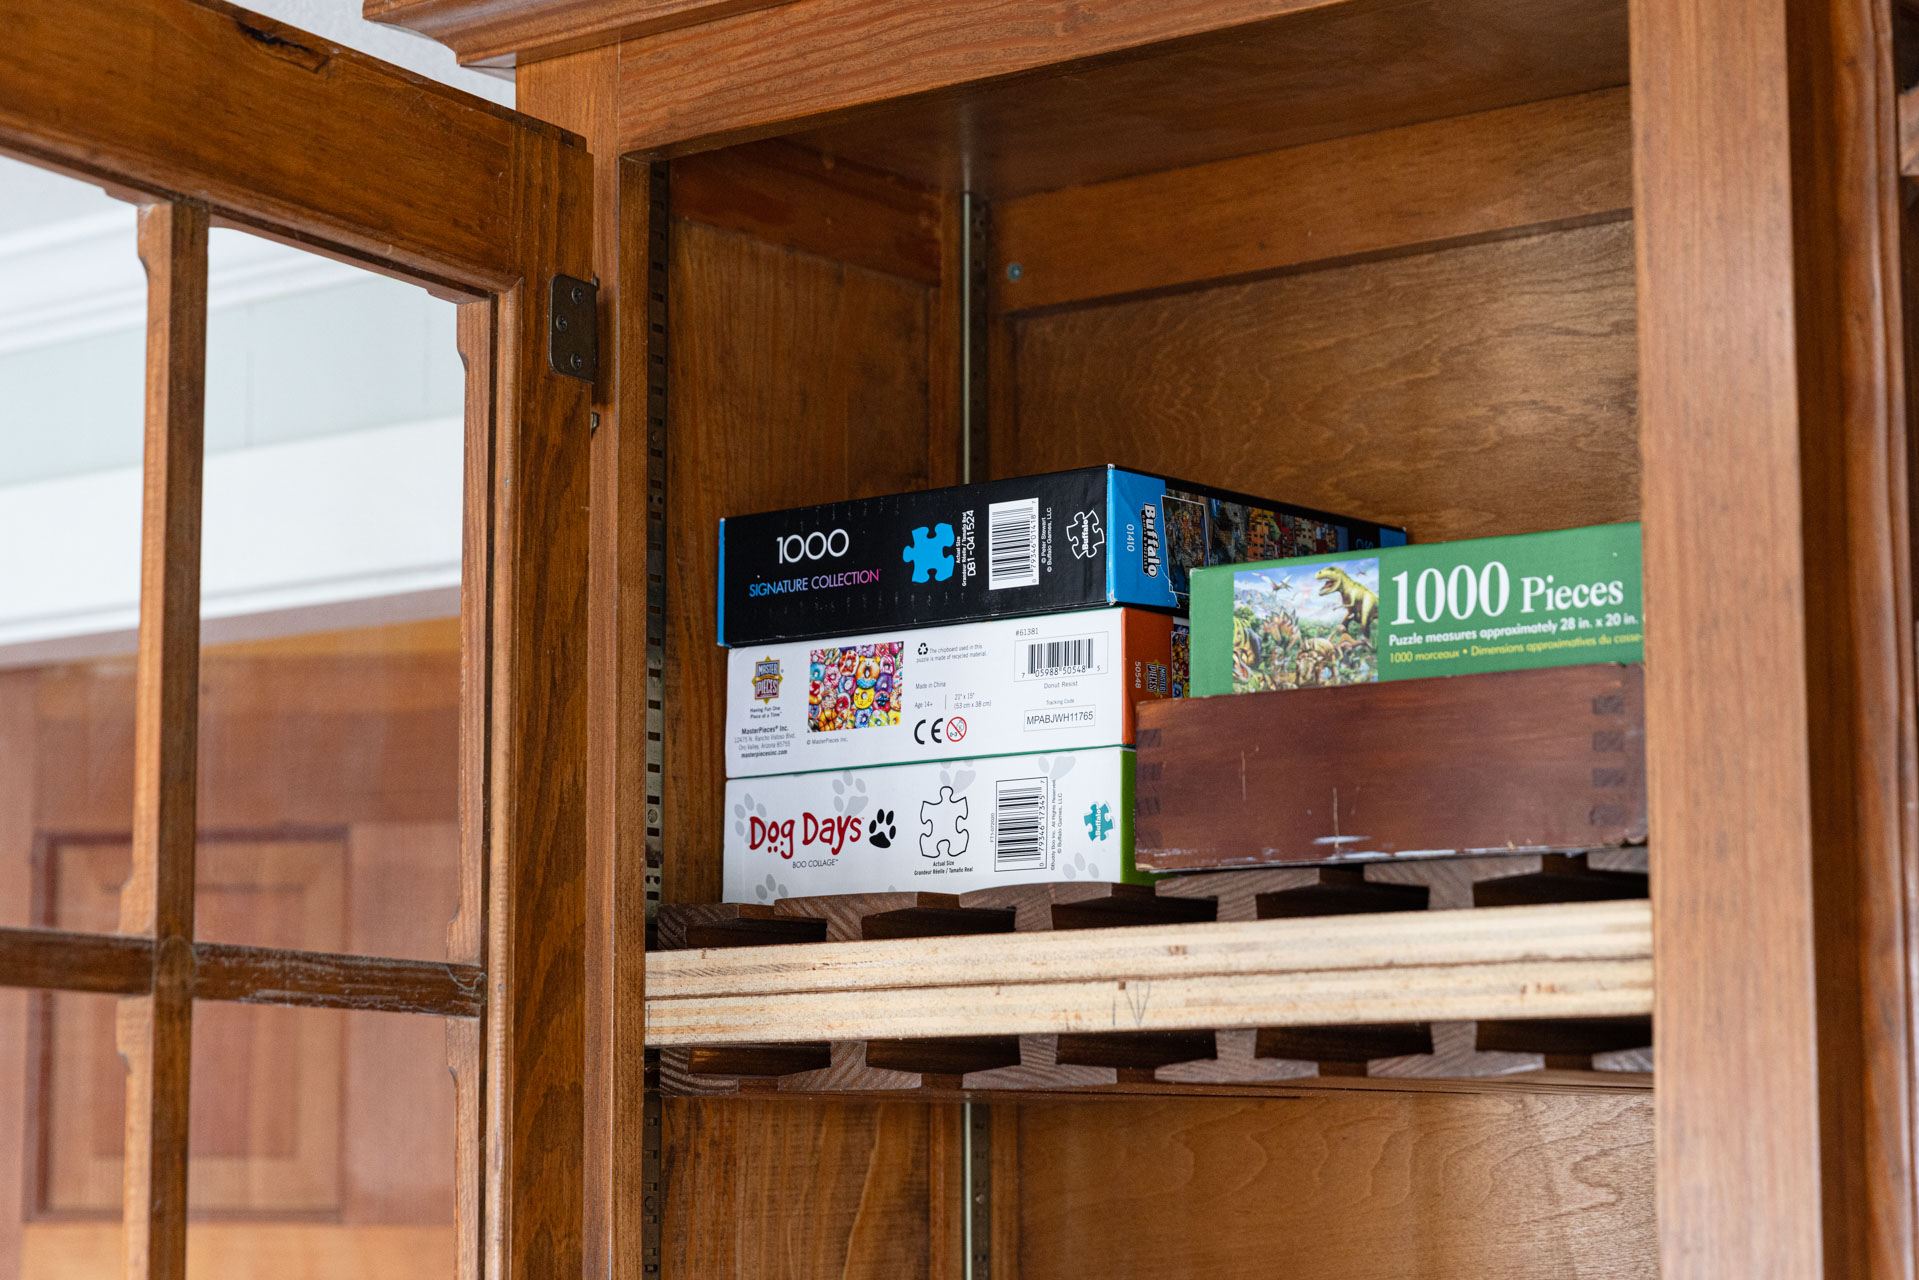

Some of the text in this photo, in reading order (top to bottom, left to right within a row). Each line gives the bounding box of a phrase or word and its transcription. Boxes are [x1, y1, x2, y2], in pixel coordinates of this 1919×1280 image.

[776, 528, 849, 564] 1000
[967, 510, 976, 576] DB1-041524
[1126, 524, 1135, 552] 01410
[1144, 504, 1160, 577] Buffalo
[749, 578, 808, 598] SIGNATURE
[1390, 561, 1623, 625] 1000 Pieces
[1016, 628, 1038, 636] #61381
[1389, 612, 1638, 646] Puzzle measures approximately 28 in. x 20 in.
[1390, 651, 1413, 663] 1000
[1415, 649, 1459, 661] morceaux
[1471, 643, 1524, 657] Dimensions
[1526, 635, 1596, 653] approximatives
[1599, 634, 1612, 645] du
[758, 664, 778, 676] MASTER
[1035, 668, 1059, 677] 05988
[1062, 665, 1086, 674] 50548
[757, 679, 778, 695] PIECES
[1027, 711, 1093, 725] MPABJWH11765
[741, 750, 787, 758] masterpiecesinc.com
[749, 812, 862, 859] Dog Days
